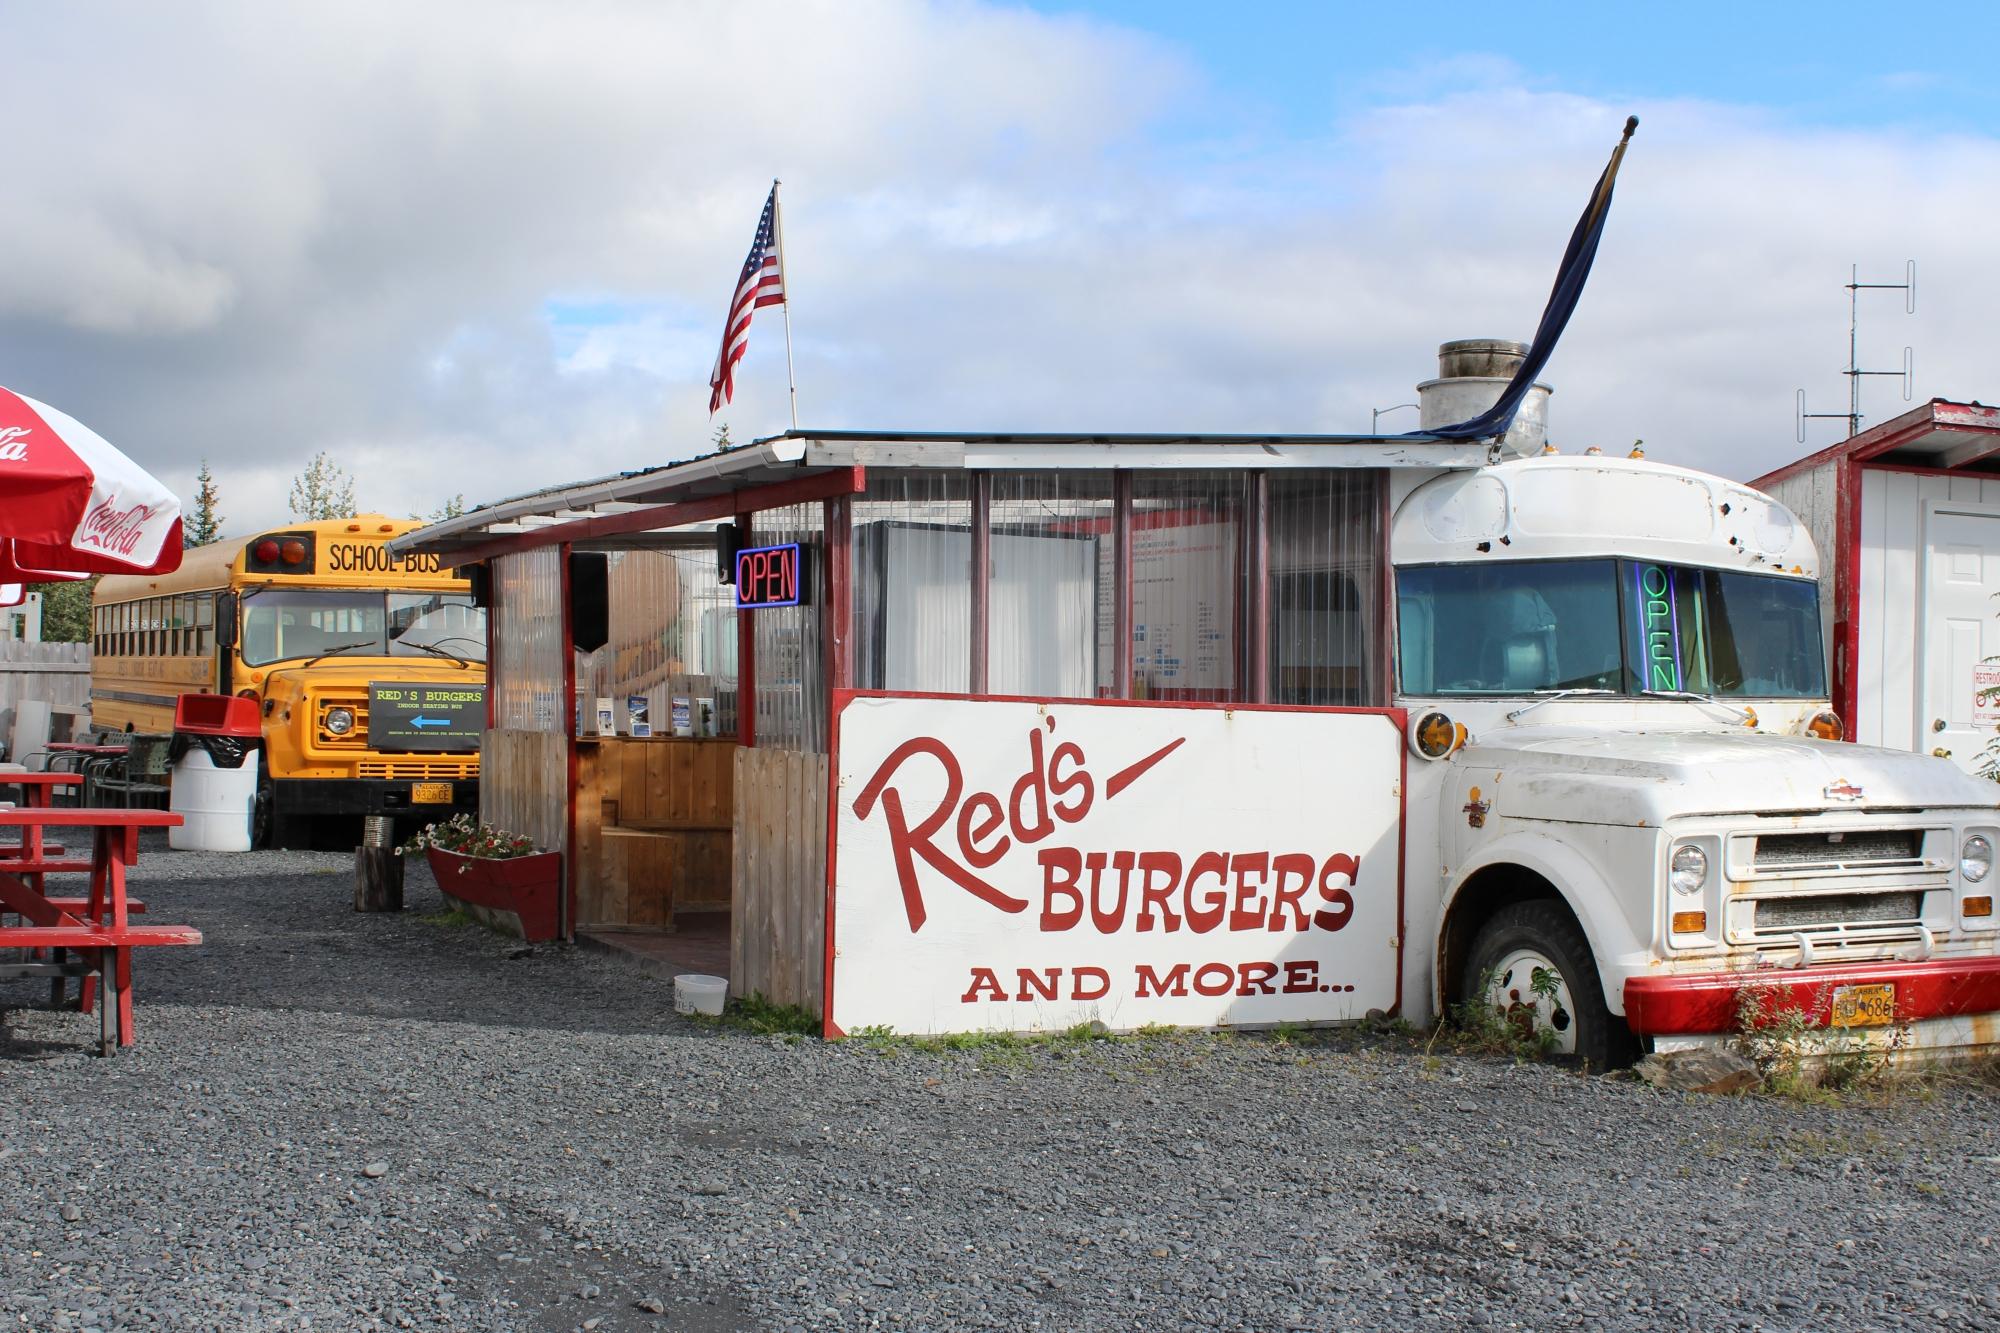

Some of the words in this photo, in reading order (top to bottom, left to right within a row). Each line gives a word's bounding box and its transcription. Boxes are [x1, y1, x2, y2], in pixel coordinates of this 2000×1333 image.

[329, 544, 397, 572] SCHOOL
[405, 553, 440, 573] BUS
[738, 549, 796, 602] OPEN
[1643, 567, 1676, 690] OPEN
[376, 690, 418, 701] RED'S
[425, 691, 482, 702] BURGERS
[852, 715, 1095, 934] Red's
[1038, 846, 1361, 934] BURGERS
[961, 967, 1111, 1003] AND
[1135, 960, 1355, 998] MORE...
